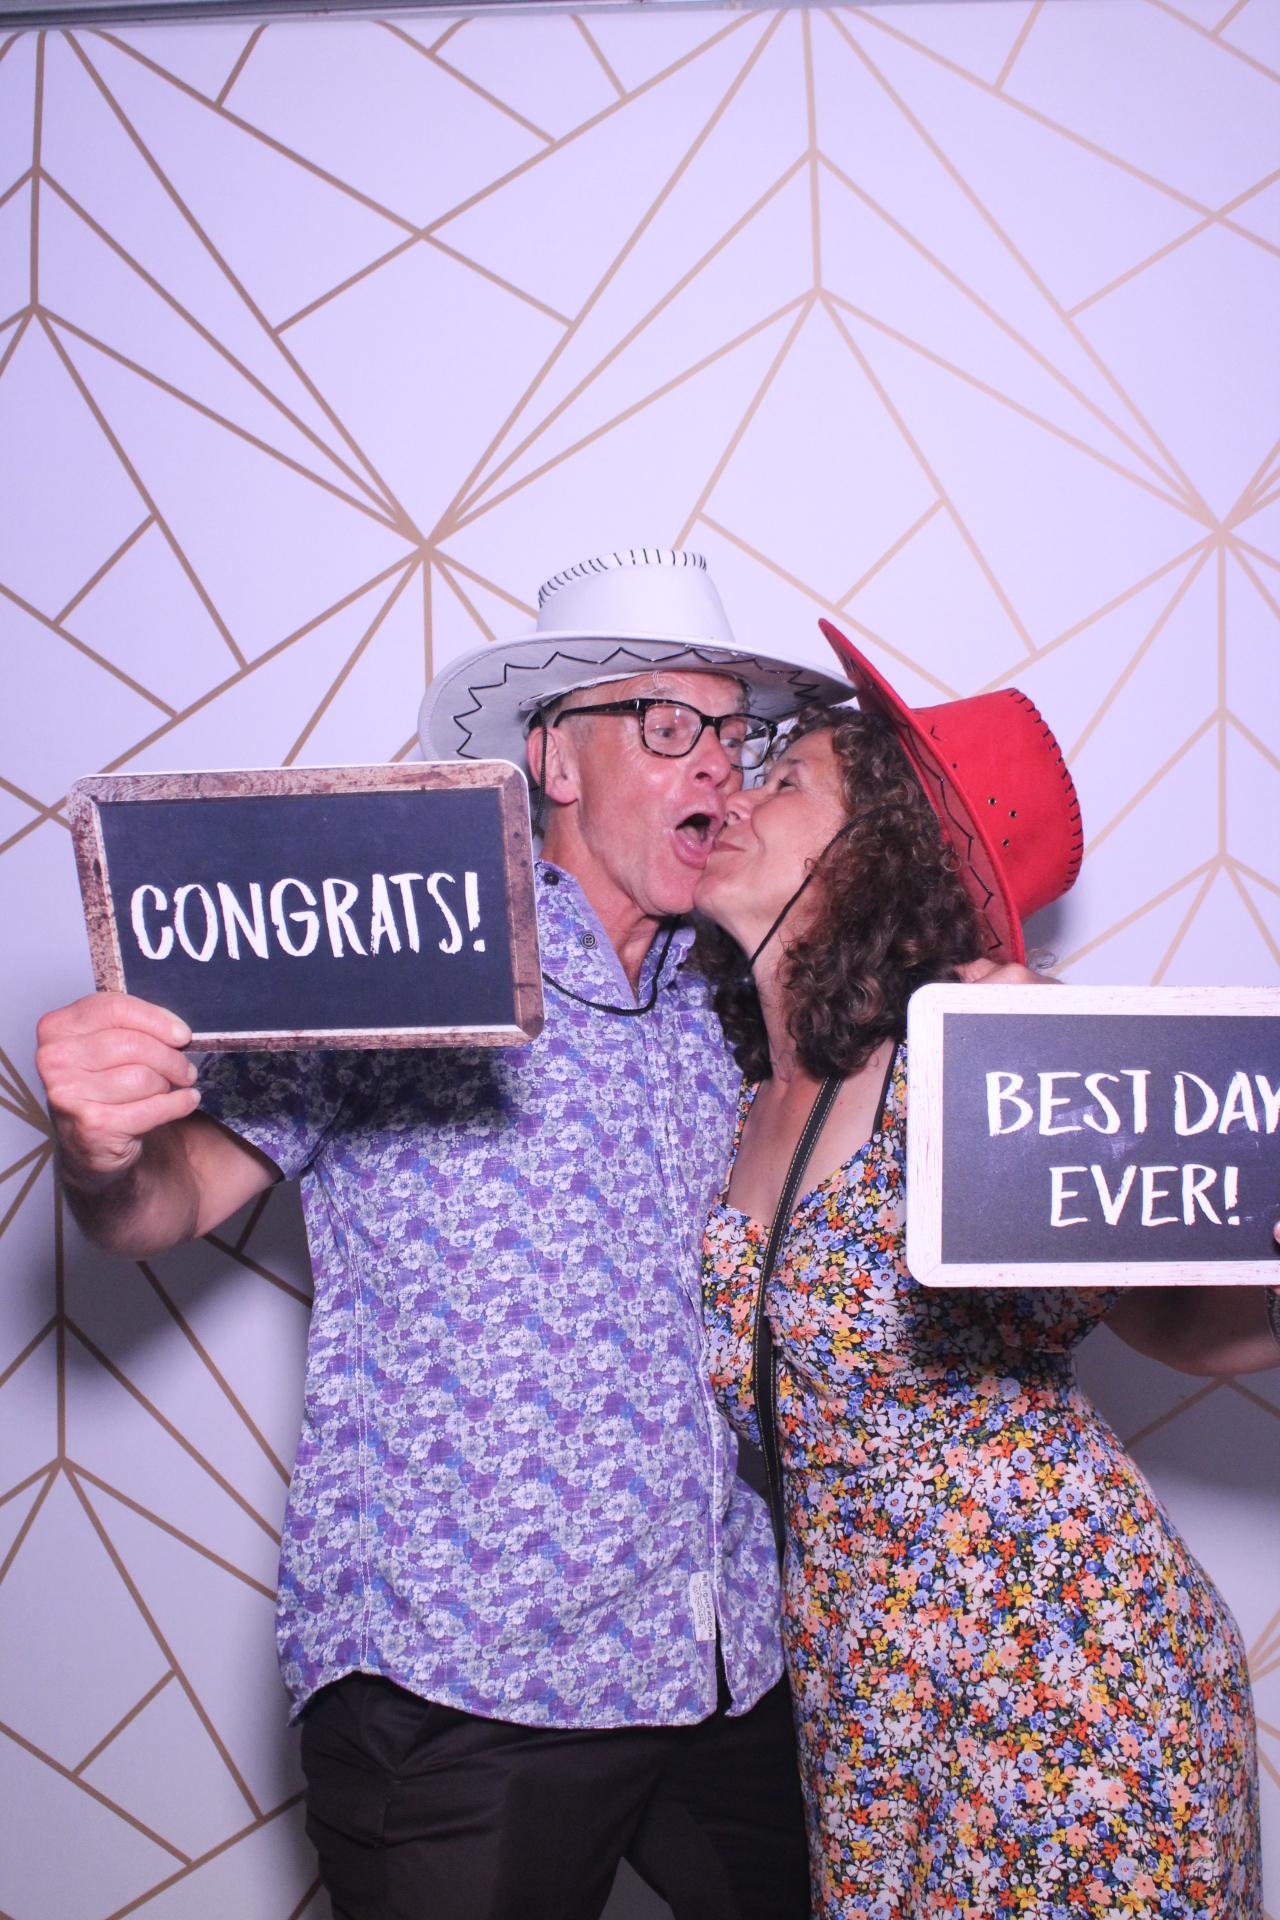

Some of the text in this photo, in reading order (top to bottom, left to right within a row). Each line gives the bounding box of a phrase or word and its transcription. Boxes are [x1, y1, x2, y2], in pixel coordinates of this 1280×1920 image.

[130, 871, 486, 962] CONGRATS!
[986, 1069, 1280, 1137] BEST DAY
[1049, 1164, 1240, 1227] EVER!
